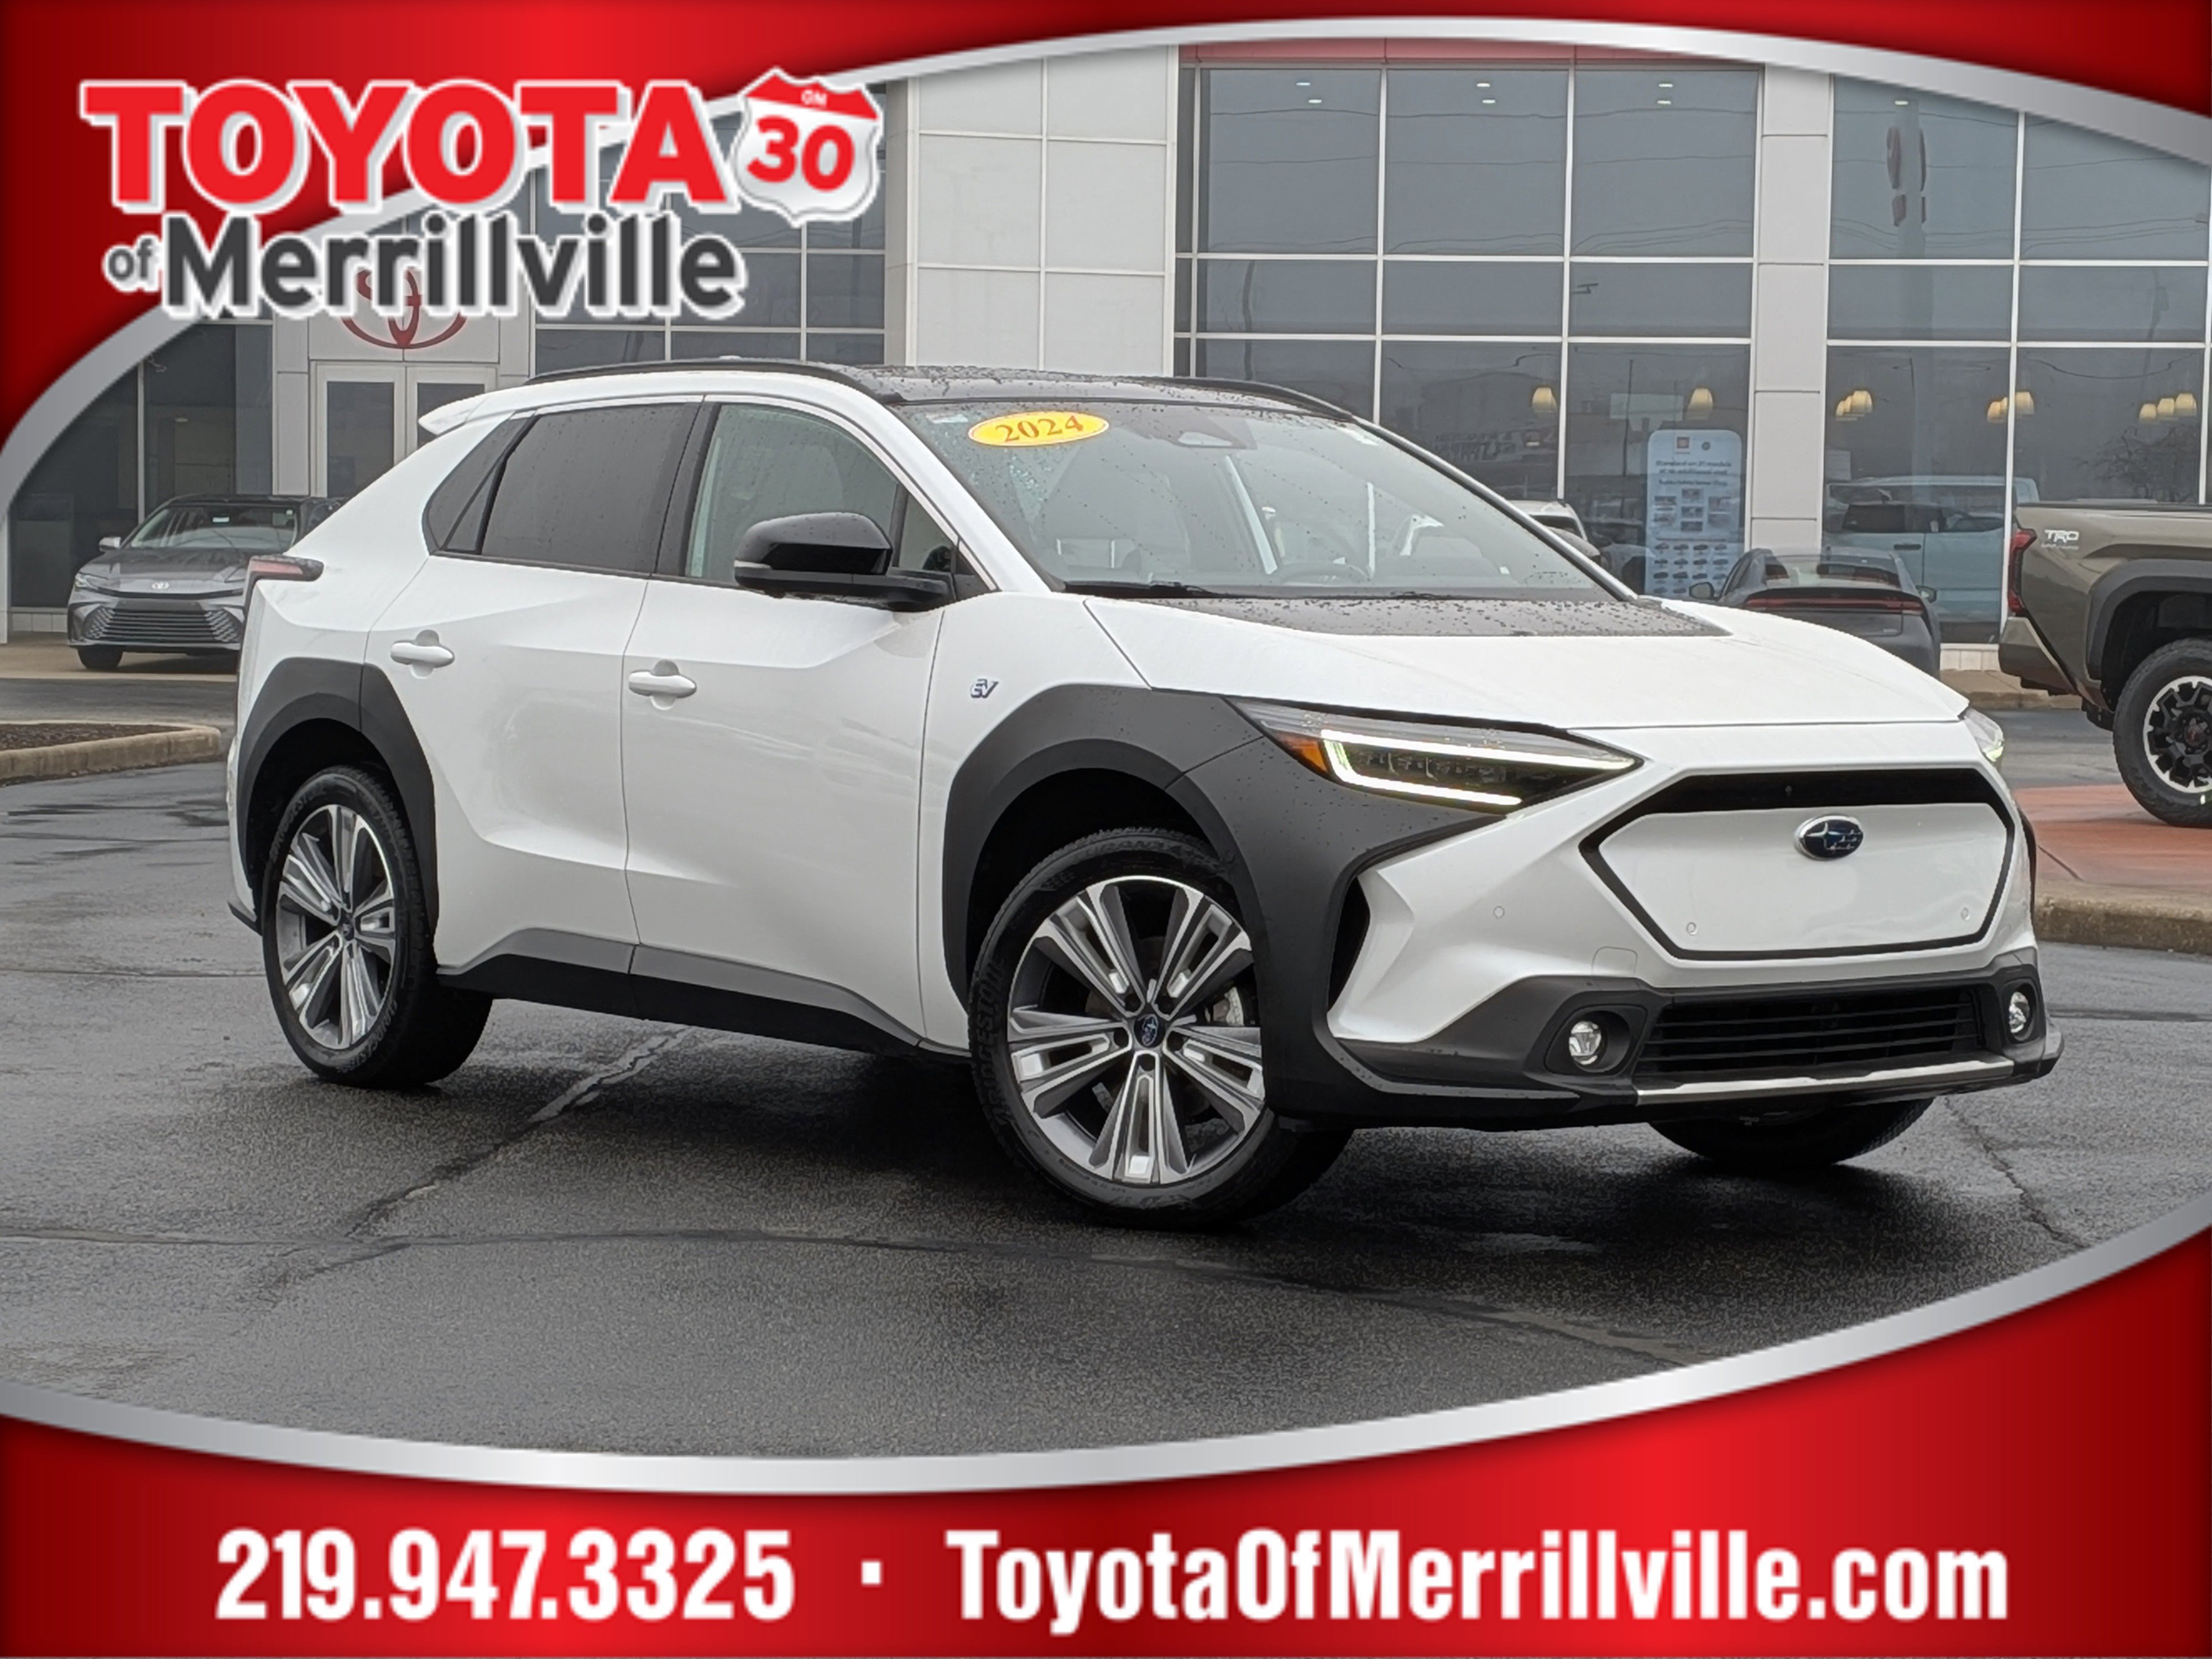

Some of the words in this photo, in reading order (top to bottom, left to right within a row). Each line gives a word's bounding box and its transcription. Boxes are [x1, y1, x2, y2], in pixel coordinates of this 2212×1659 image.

[995, 415, 1083, 442] 2024
[2044, 529, 2079, 542] TRD
[971, 679, 999, 698] EV
